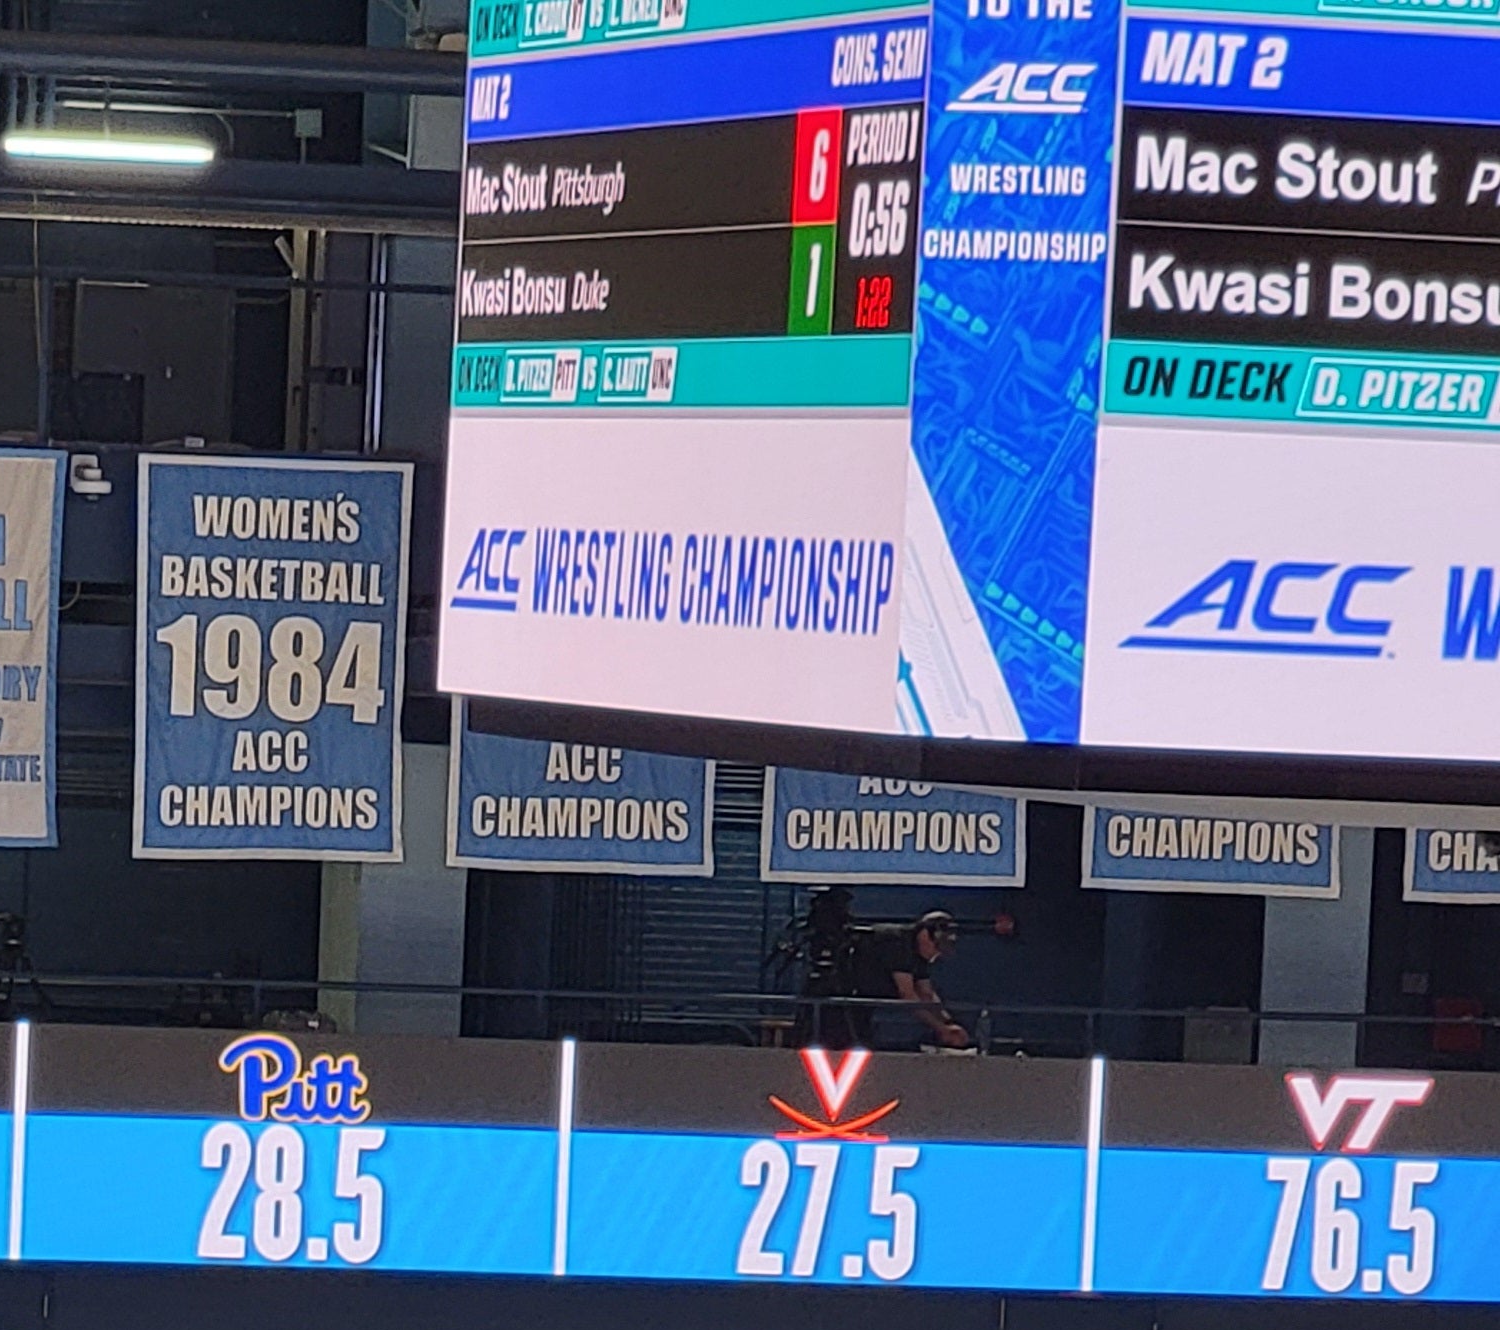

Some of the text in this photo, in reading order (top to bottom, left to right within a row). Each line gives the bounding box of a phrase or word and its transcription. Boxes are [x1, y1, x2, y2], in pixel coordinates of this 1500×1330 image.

[831, 28, 928, 88] CONS. SEMI
[958, 62, 1098, 102] ACC
[1140, 29, 1289, 90] MAT 2
[471, 74, 512, 122] MAT 2
[808, 129, 831, 203] 6
[846, 110, 908, 167] PERIOD
[465, 161, 626, 216] Mac Stout Pittsburgh
[949, 162, 1088, 196] WRESTLING
[1134, 133, 1500, 206] Mac Stout P
[847, 180, 910, 259] 0:56
[922, 229, 1107, 263] CHAMPIONSHIP
[461, 269, 611, 318] Kwasi Bonsu Duke
[804, 243, 823, 317] 1
[854, 276, 893, 329] 1:22
[1128, 253, 1310, 317] Kwasi
[1122, 355, 1485, 414] ON DECK D. PITZER
[193, 492, 360, 544] WOMEN'S
[161, 556, 384, 605] BASKETBALL
[456, 527, 895, 635] ACC WRESTLING CHAMPIONSHIP
[1144, 559, 1415, 637] ACC
[156, 613, 386, 725] 1984
[232, 730, 308, 773] ACC
[545, 741, 622, 782] ACC
[159, 785, 378, 831] CHAMPIONS
[472, 795, 690, 843] CHAMPIONS
[786, 807, 1000, 855] CHAMPIONS
[1107, 813, 1319, 864] CHAMPIONS
[196, 1121, 387, 1265] 28.5
[735, 1140, 920, 1282] 27.5
[1260, 1157, 1440, 1295] 76.5
